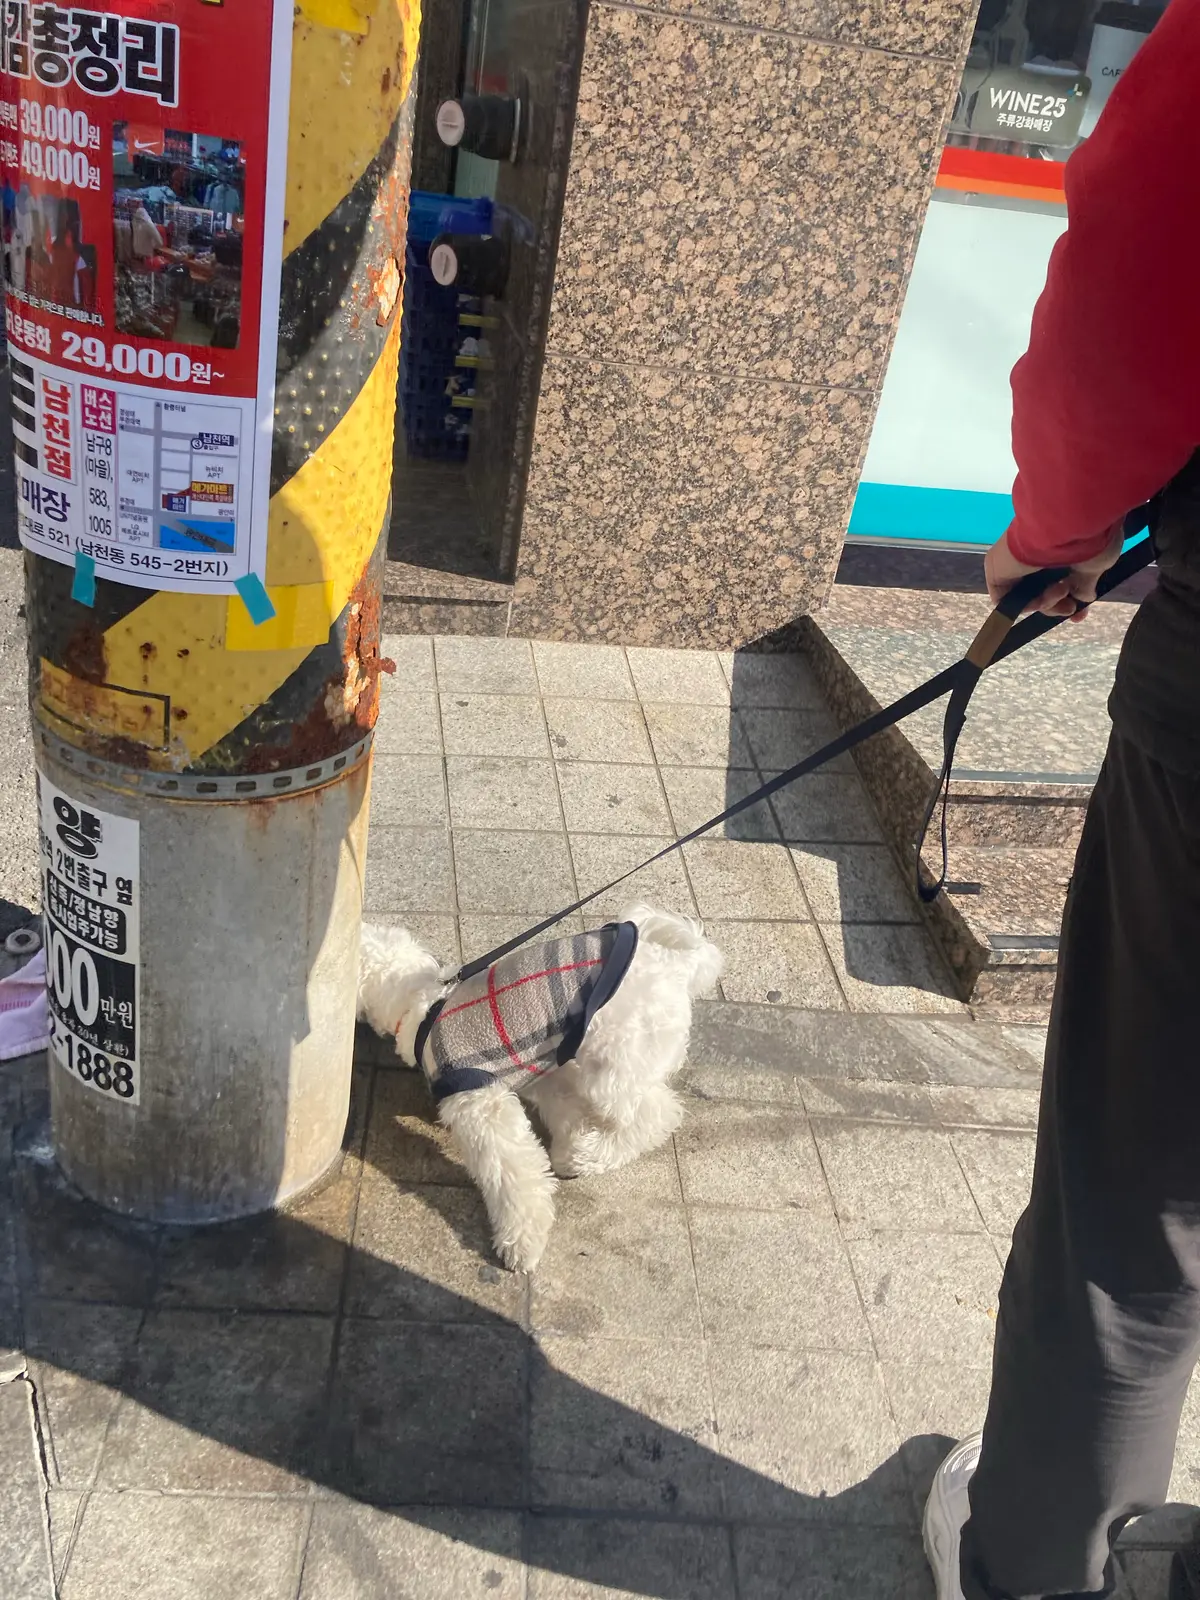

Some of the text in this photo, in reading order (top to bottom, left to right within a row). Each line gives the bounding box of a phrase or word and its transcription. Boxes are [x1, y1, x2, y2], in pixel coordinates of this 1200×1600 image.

[1101, 66, 1123, 77] CAF
[989, 87, 1068, 118] WINE25
[996, 113, 1053, 132] 주류강화매장
[84, 388, 112, 408] 버스
[42, 378, 72, 480] 남천점
[84, 409, 113, 432] 노선
[85, 434, 112, 456] 남구8
[21, 476, 72, 523] 매장
[89, 515, 112, 536] 1005
[48, 527, 70, 547] 521
[130, 553, 229, 577] 545-2번지)
